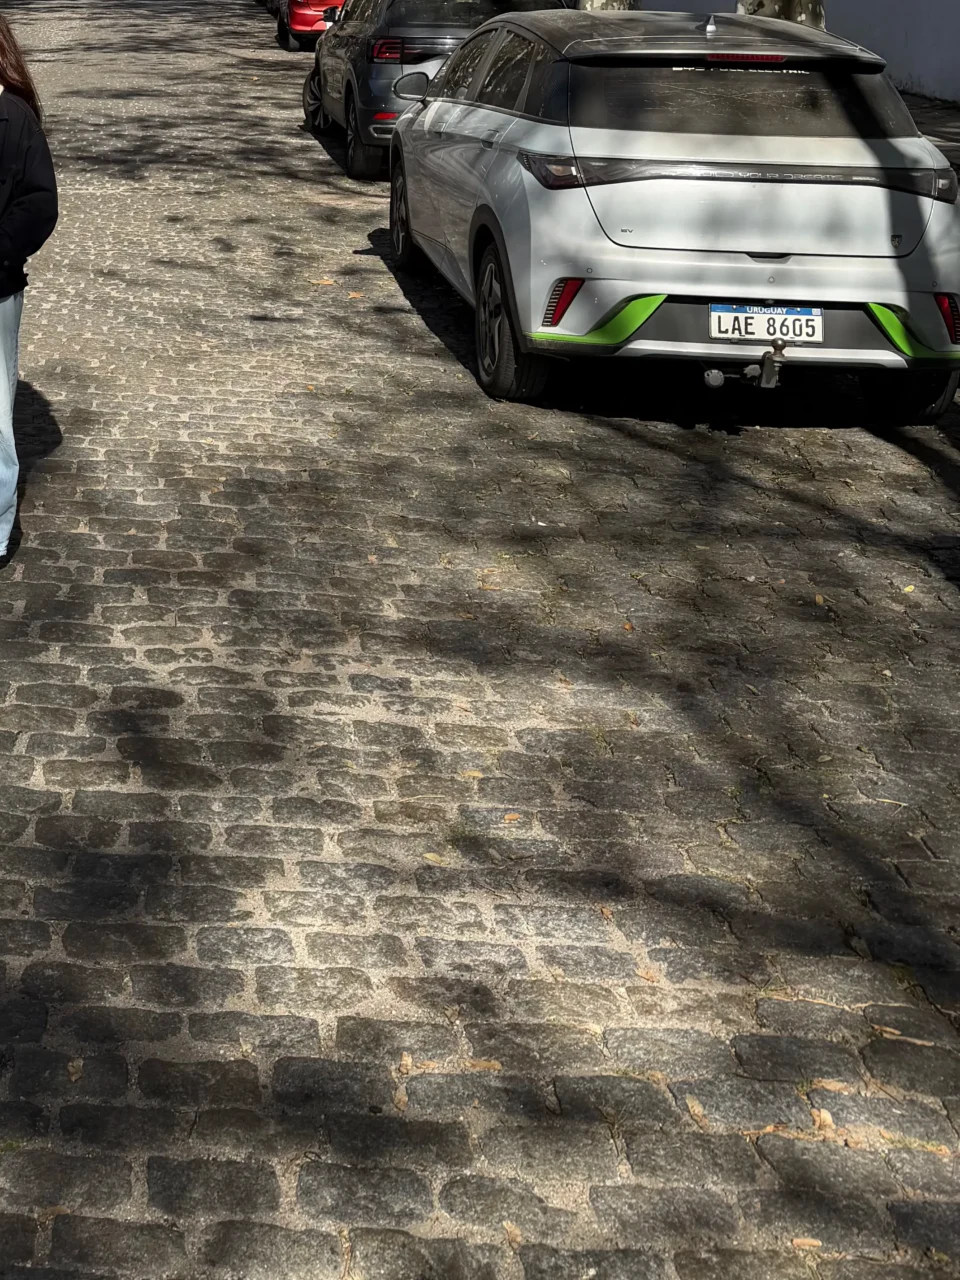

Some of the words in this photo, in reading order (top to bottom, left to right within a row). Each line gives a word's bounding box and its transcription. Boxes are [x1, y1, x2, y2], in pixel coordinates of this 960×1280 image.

[746, 306, 787, 315] URUGUAY
[717, 315, 756, 335] LAE
[766, 317, 816, 338] 8605
